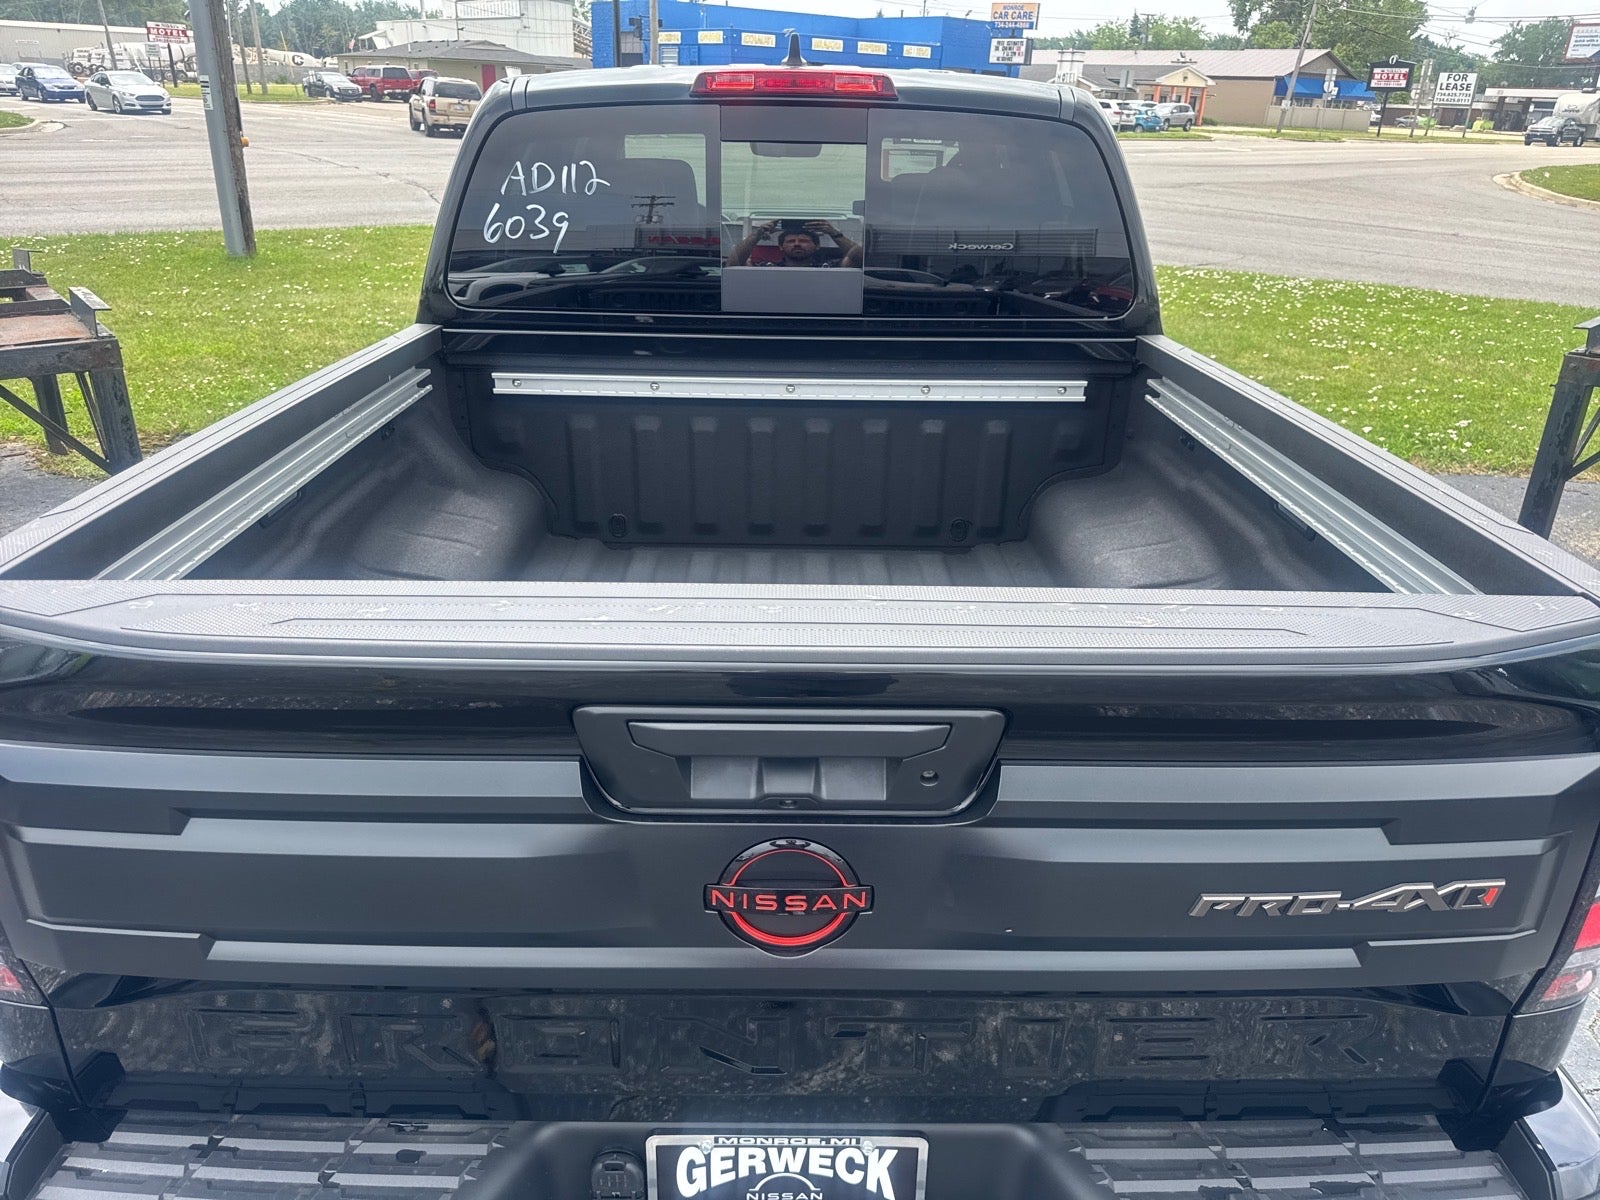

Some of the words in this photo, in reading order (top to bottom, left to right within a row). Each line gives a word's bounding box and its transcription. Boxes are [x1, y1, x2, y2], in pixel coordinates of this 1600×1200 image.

[993, 11, 1009, 20] CAR
[1011, 11, 1033, 20] CARE
[150, 27, 185, 36] MOTEL
[1447, 73, 1468, 82] FOR
[1440, 82, 1472, 91] LEASE
[501, 160, 611, 196] AD112
[483, 202, 569, 254] 6039
[710, 889, 867, 912] NISSAN
[1188, 878, 1506, 917] PRO-4X
[718, 1137, 825, 1146] MONROE,
[827, 1137, 856, 1146] MI
[676, 1147, 899, 1200] GERWECK
[746, 1192, 823, 1200] NISSAN
